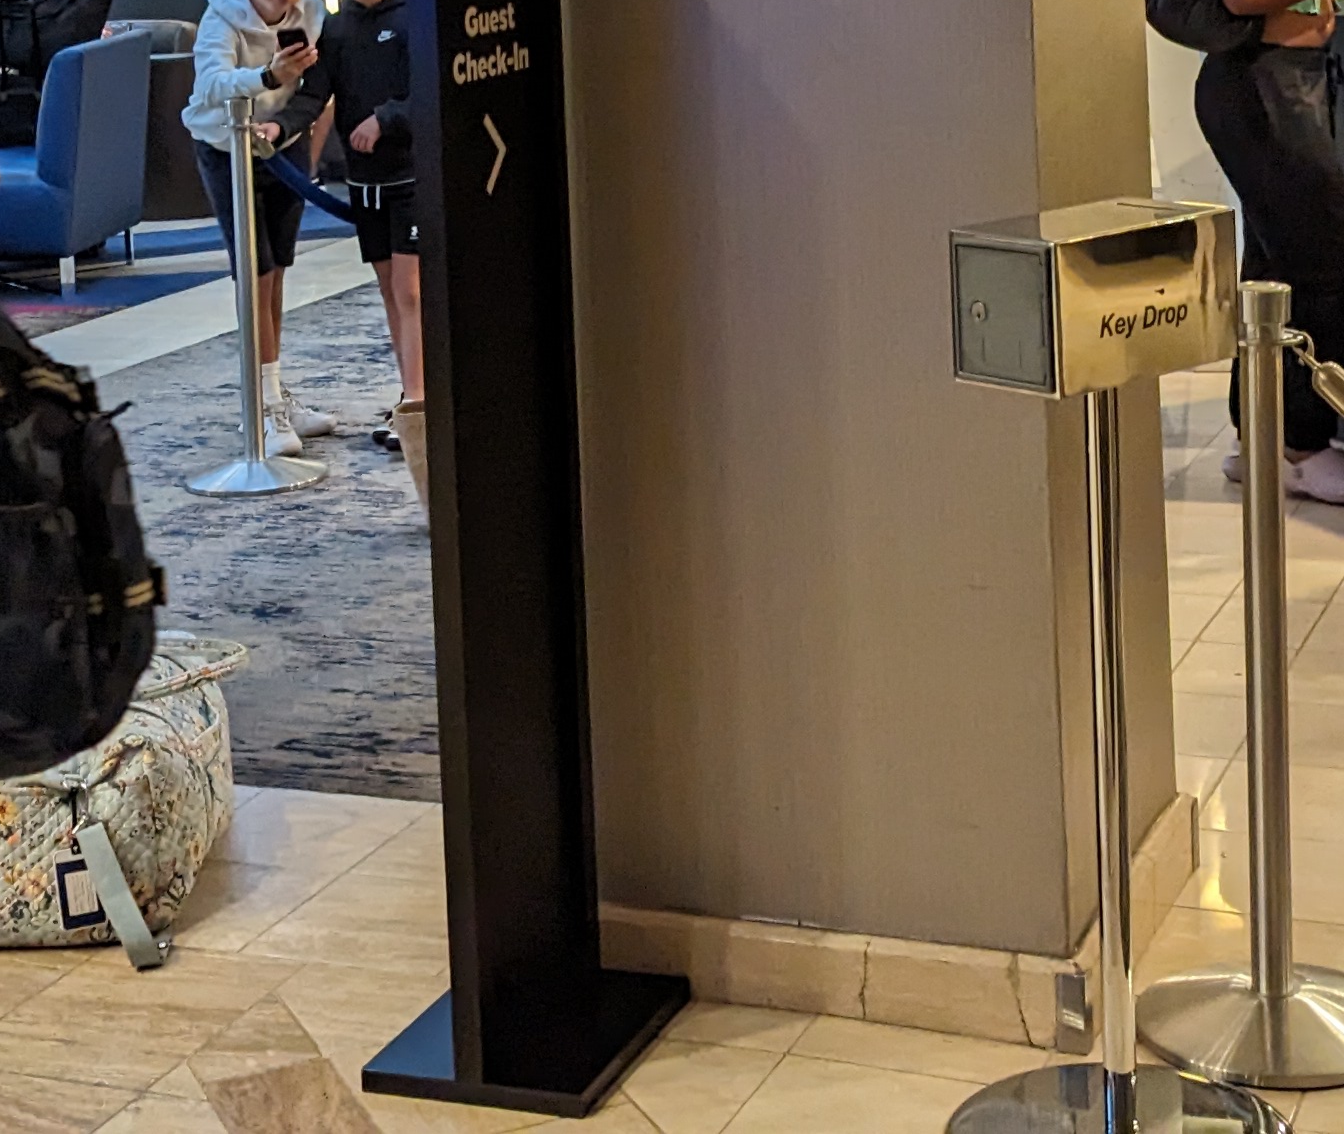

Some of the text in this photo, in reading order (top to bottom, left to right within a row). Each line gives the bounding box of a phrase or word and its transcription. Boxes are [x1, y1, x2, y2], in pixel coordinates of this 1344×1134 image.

[464, 2, 516, 38] Guest
[452, 41, 530, 85] Check-In
[1099, 303, 1188, 339] Key Drop
